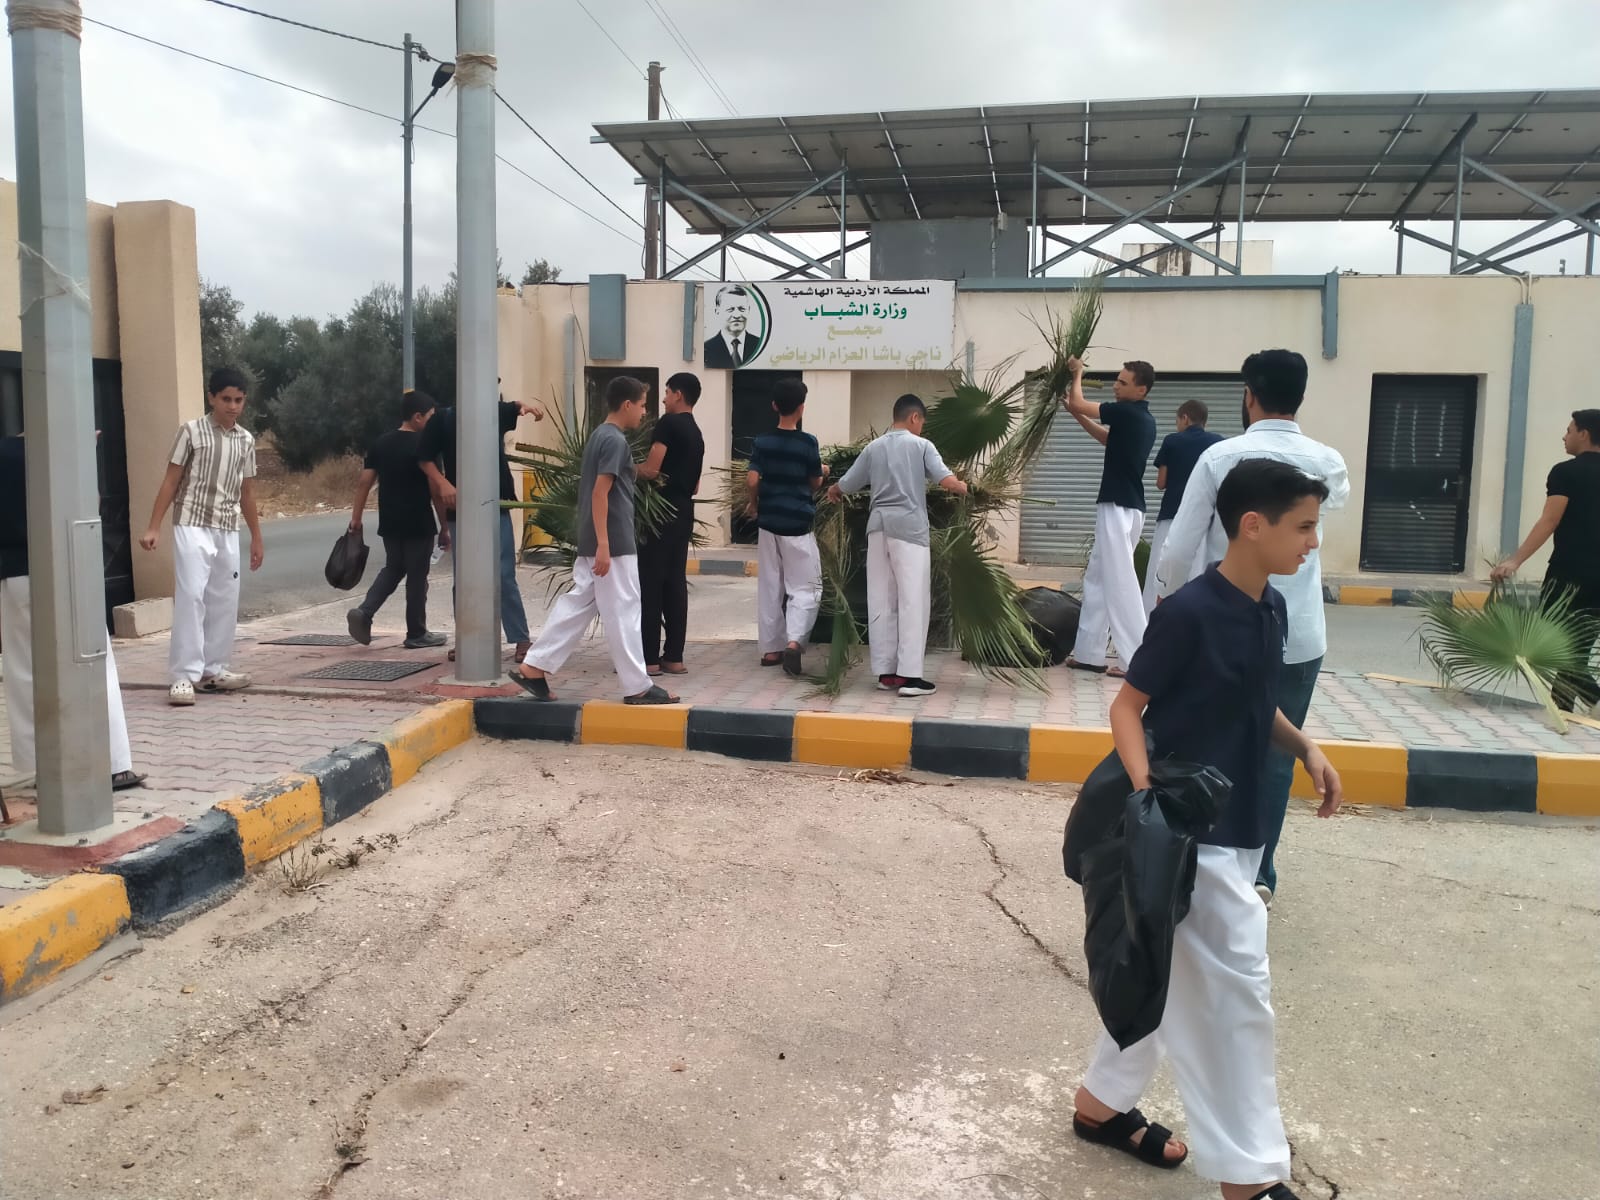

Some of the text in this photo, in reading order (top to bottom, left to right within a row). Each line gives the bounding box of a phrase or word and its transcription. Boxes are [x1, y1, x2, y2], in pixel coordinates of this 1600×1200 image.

[784, 285, 930, 298] المملكة الأردنية الهاشمية
[804, 302, 908, 320] وزارة الشباب
[769, 346, 942, 365] ناجي باشا العزام الرياضي
